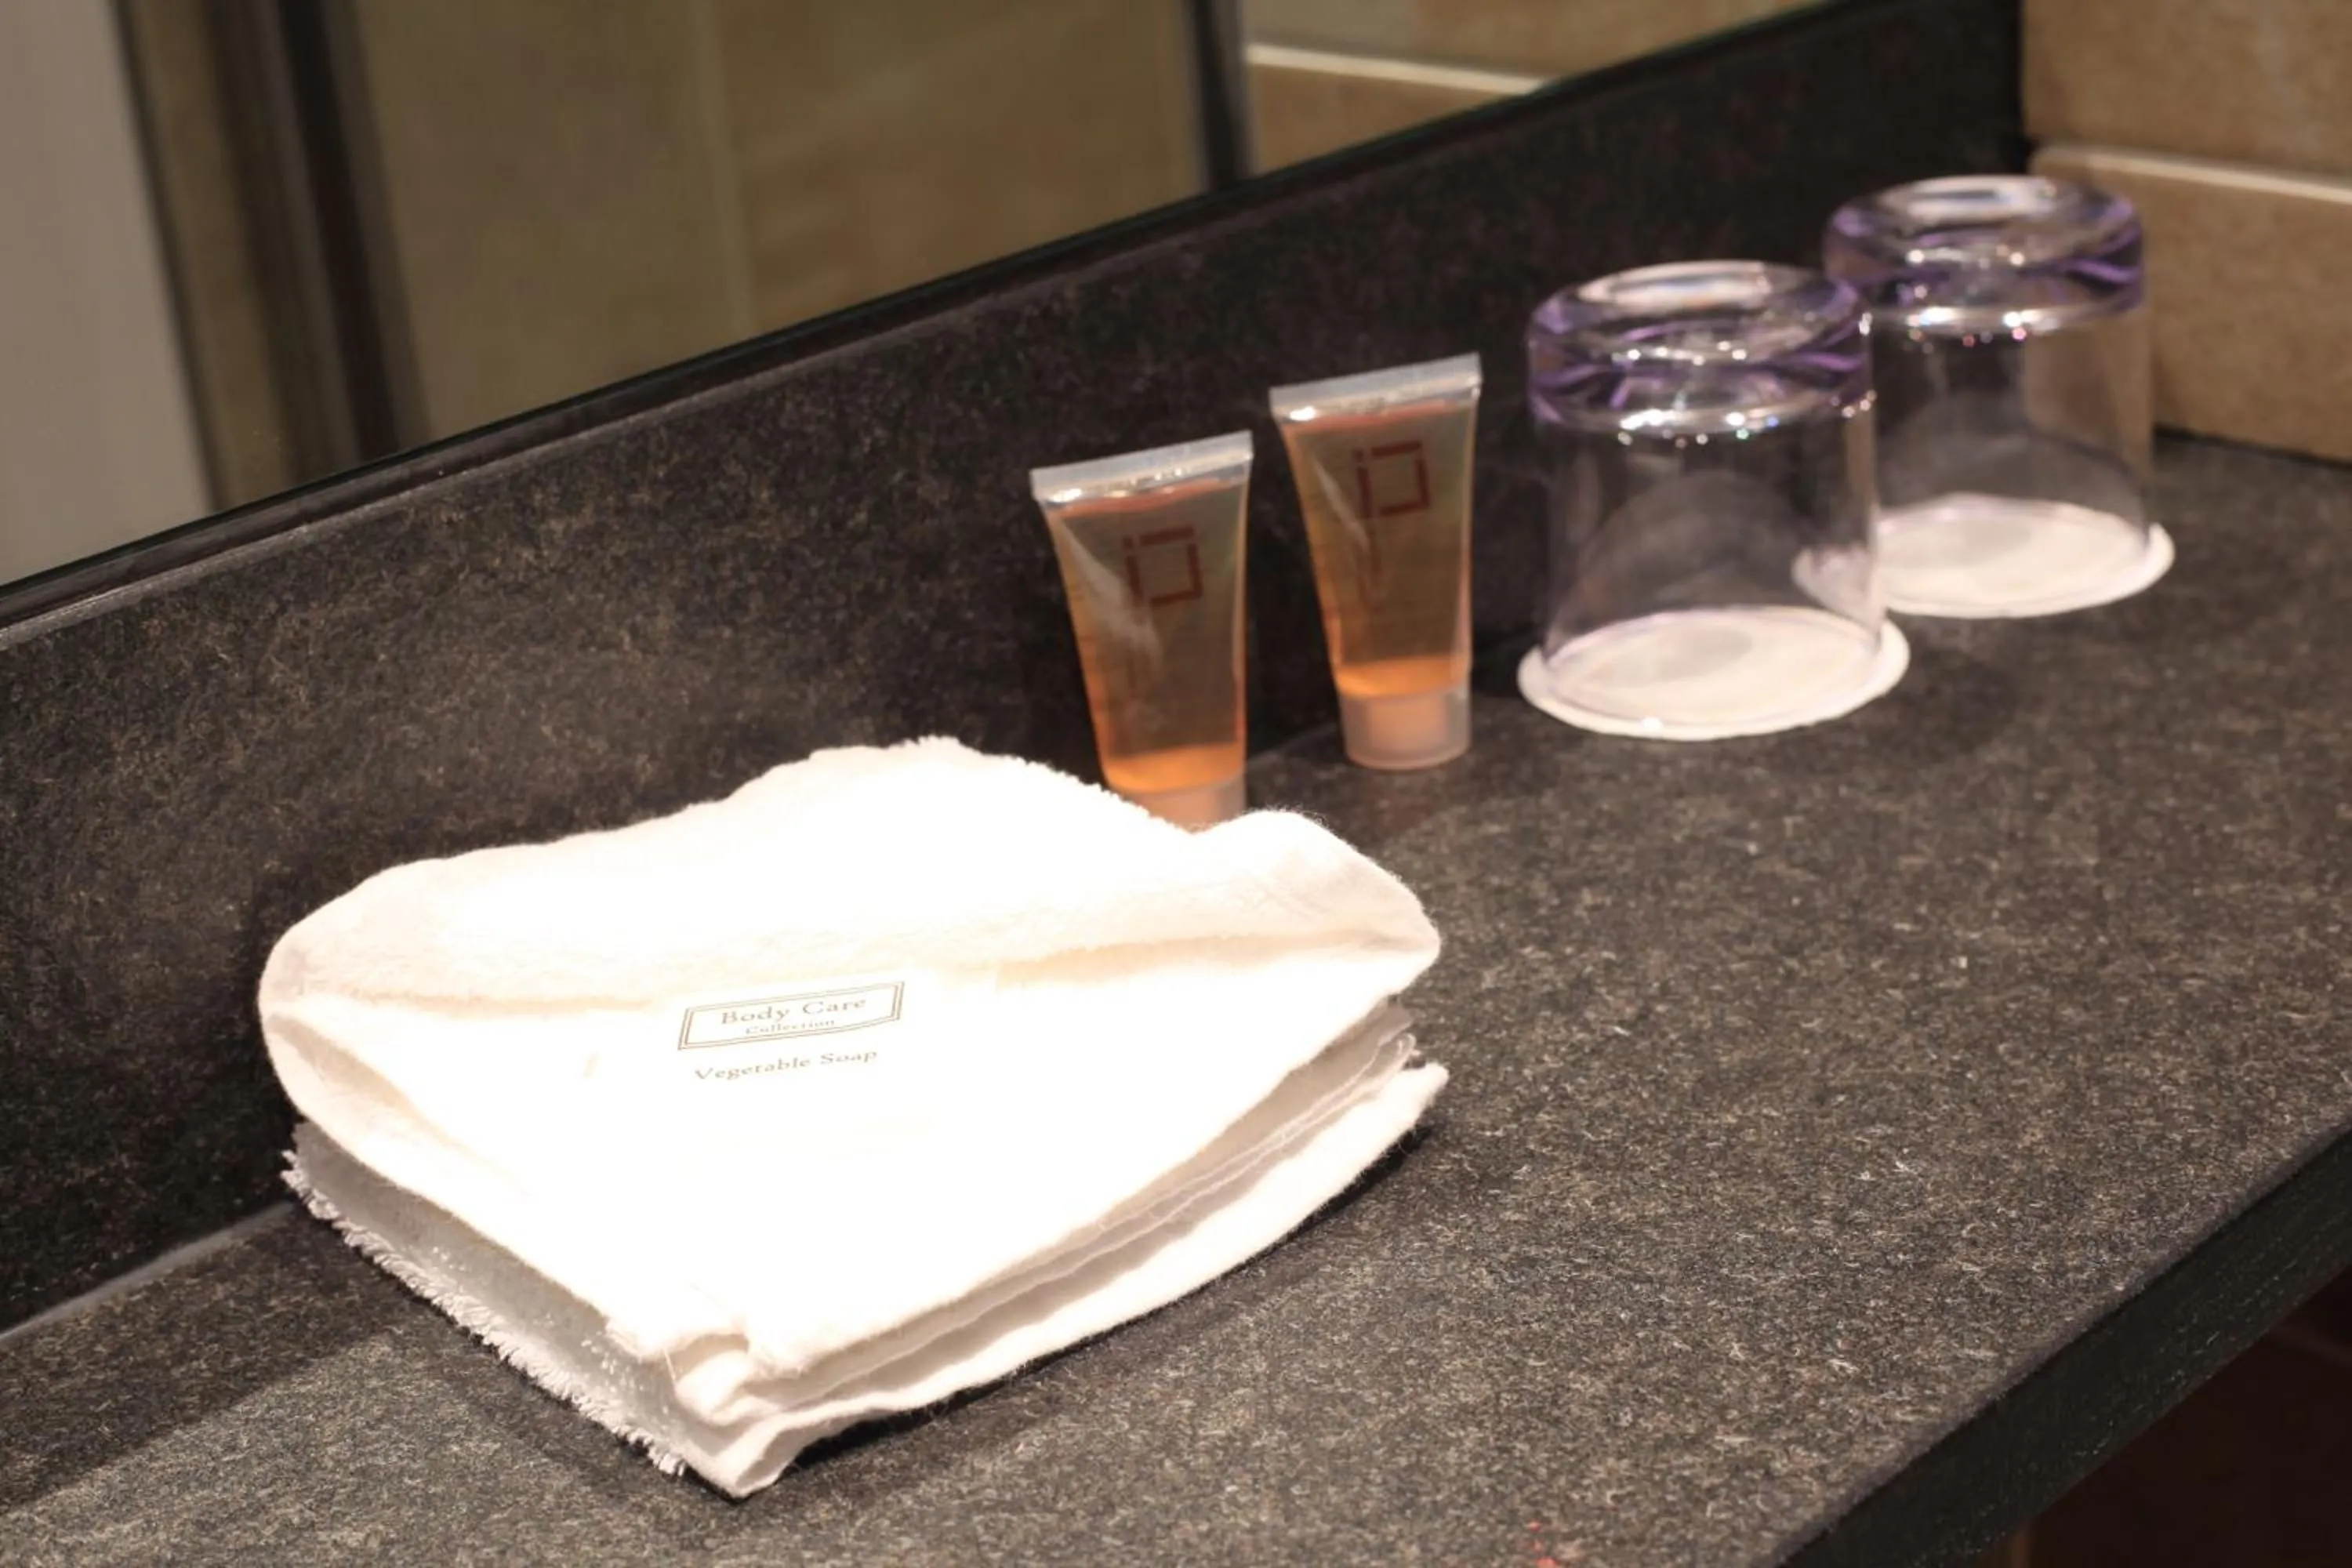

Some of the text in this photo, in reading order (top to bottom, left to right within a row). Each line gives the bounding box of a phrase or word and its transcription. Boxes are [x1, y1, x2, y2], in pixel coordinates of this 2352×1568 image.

[721, 999, 866, 1024] Body Care
[746, 1019, 835, 1034] Collection
[695, 1051, 877, 1080] Vegetable Soap
